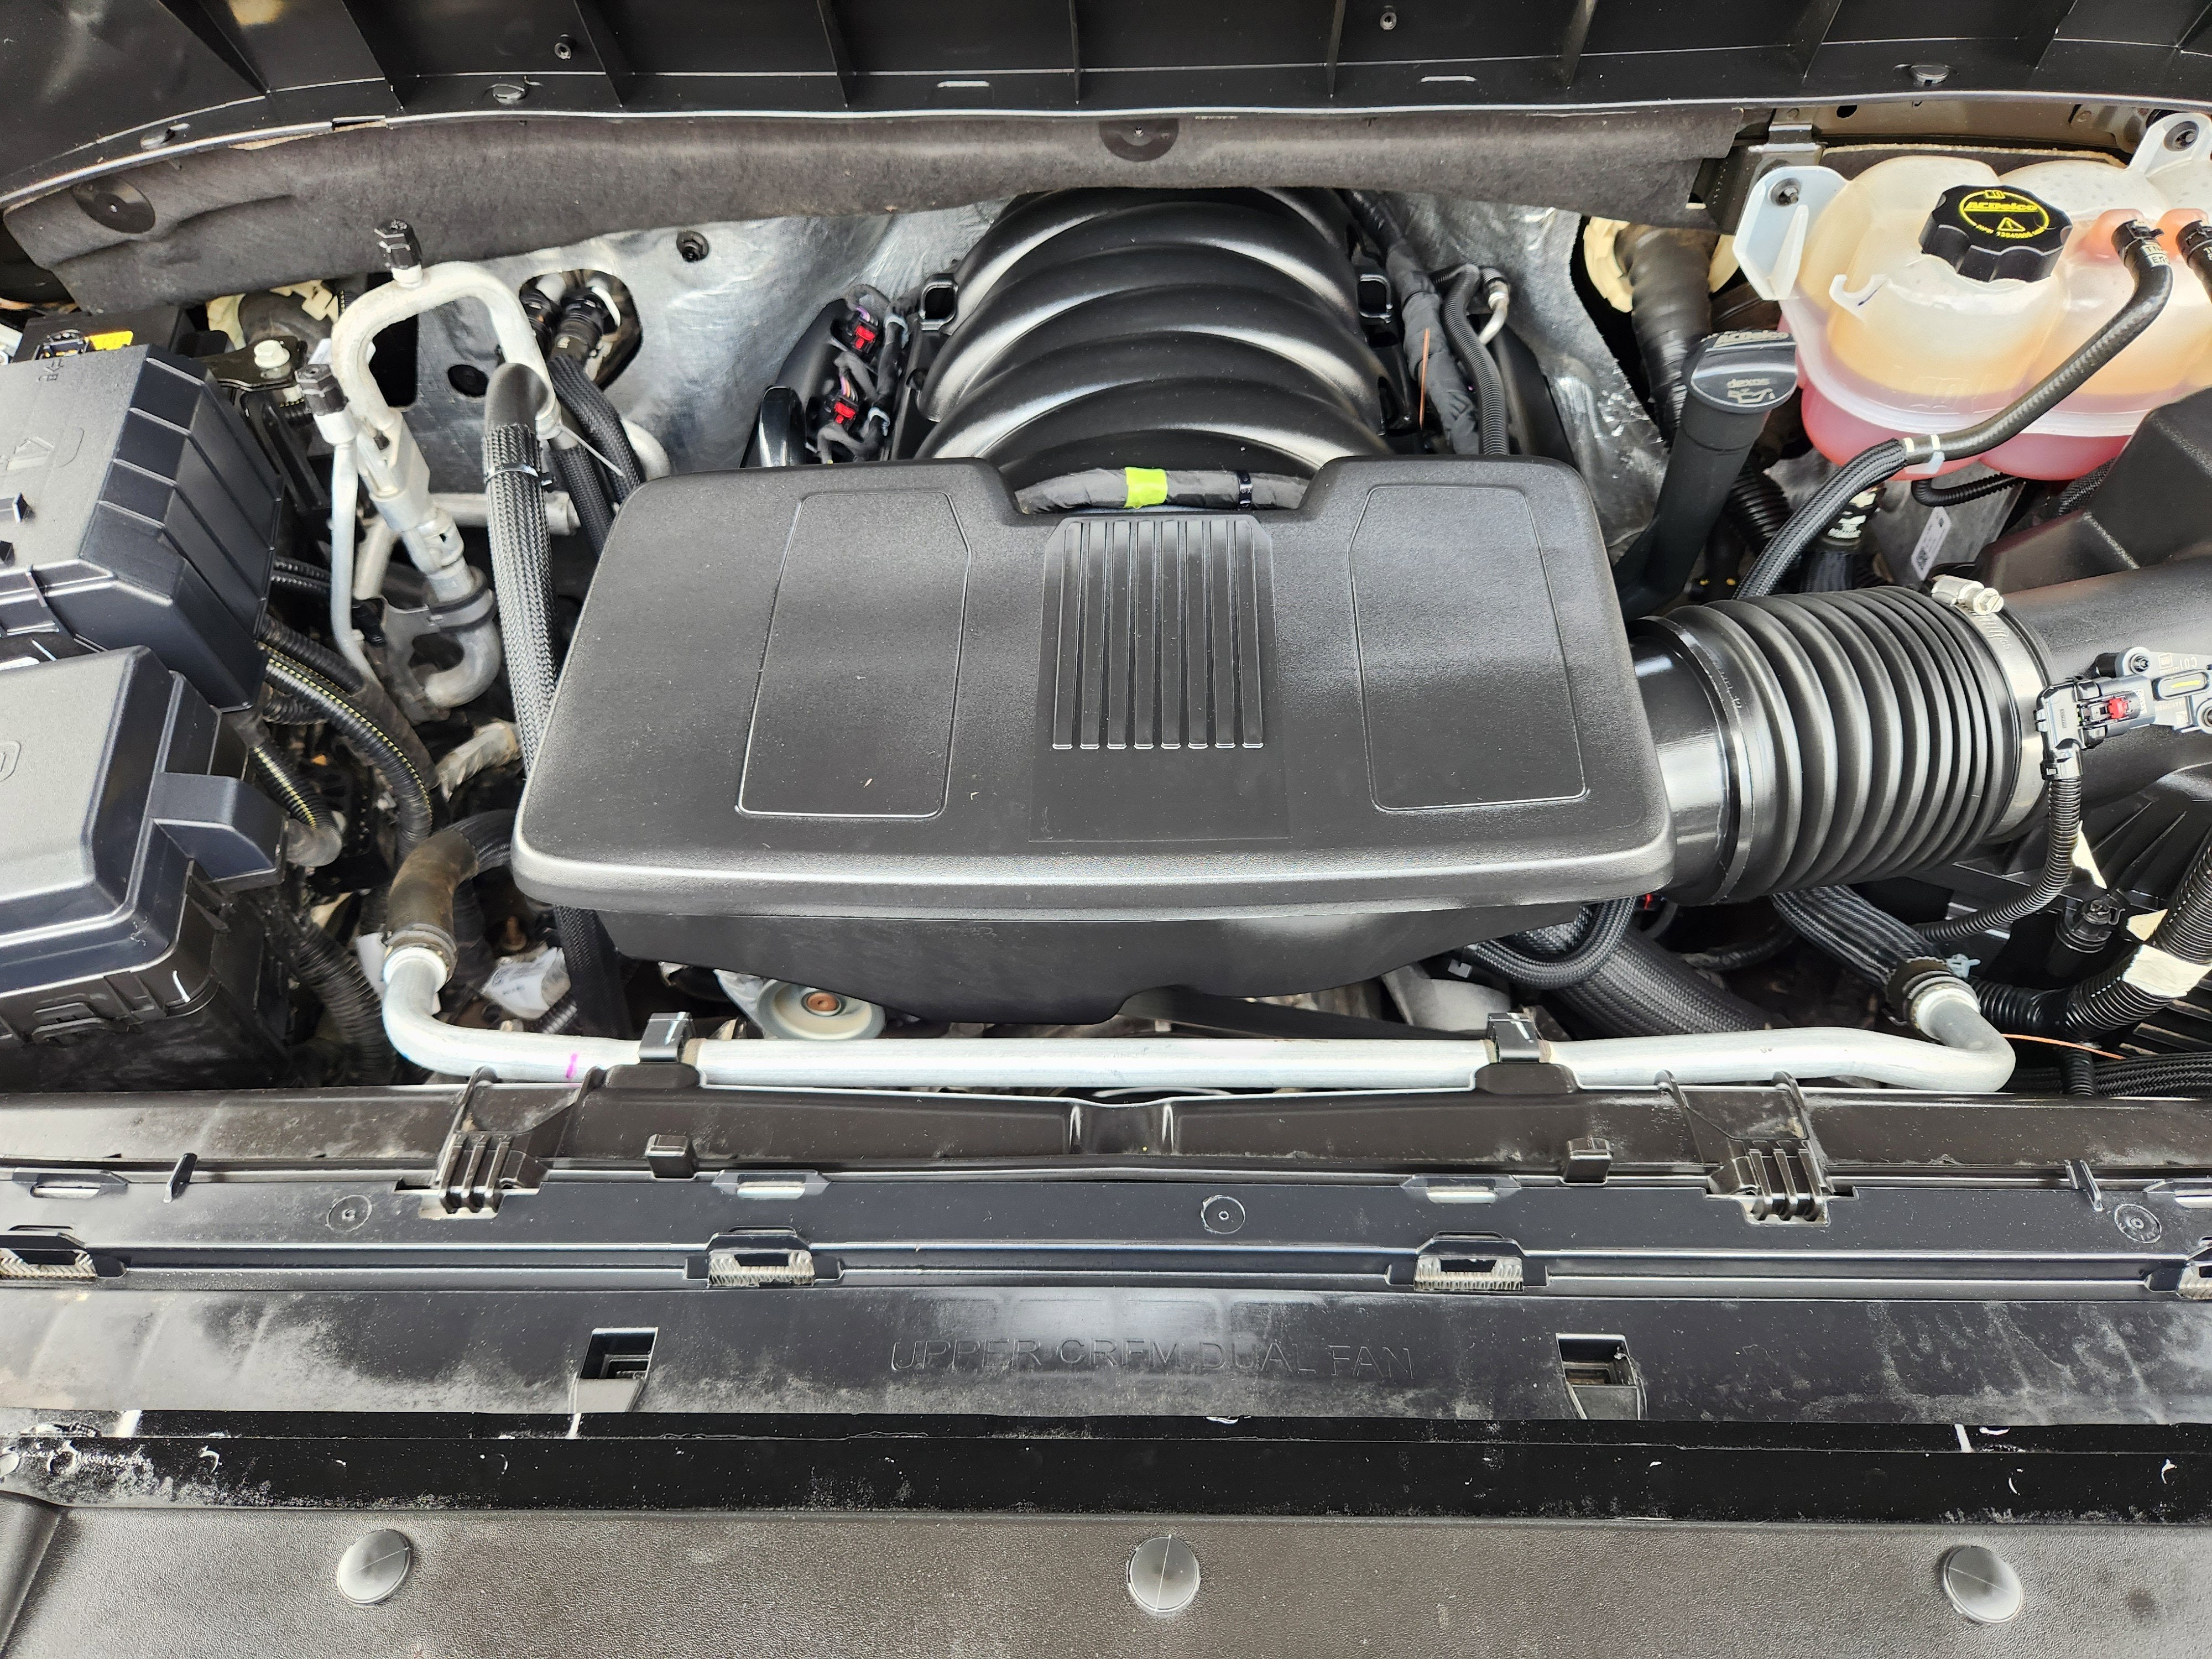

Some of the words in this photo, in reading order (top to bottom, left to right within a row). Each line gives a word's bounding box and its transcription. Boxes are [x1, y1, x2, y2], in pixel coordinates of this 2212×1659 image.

[1964, 201, 2038, 212] ACDelco
[1714, 330, 1790, 346] ACDelco
[890, 1338, 1042, 1371] UPPER
[1057, 1338, 1181, 1368] CRFM
[1200, 1340, 1316, 1374] DUAL
[1328, 1344, 1414, 1379] FAN
